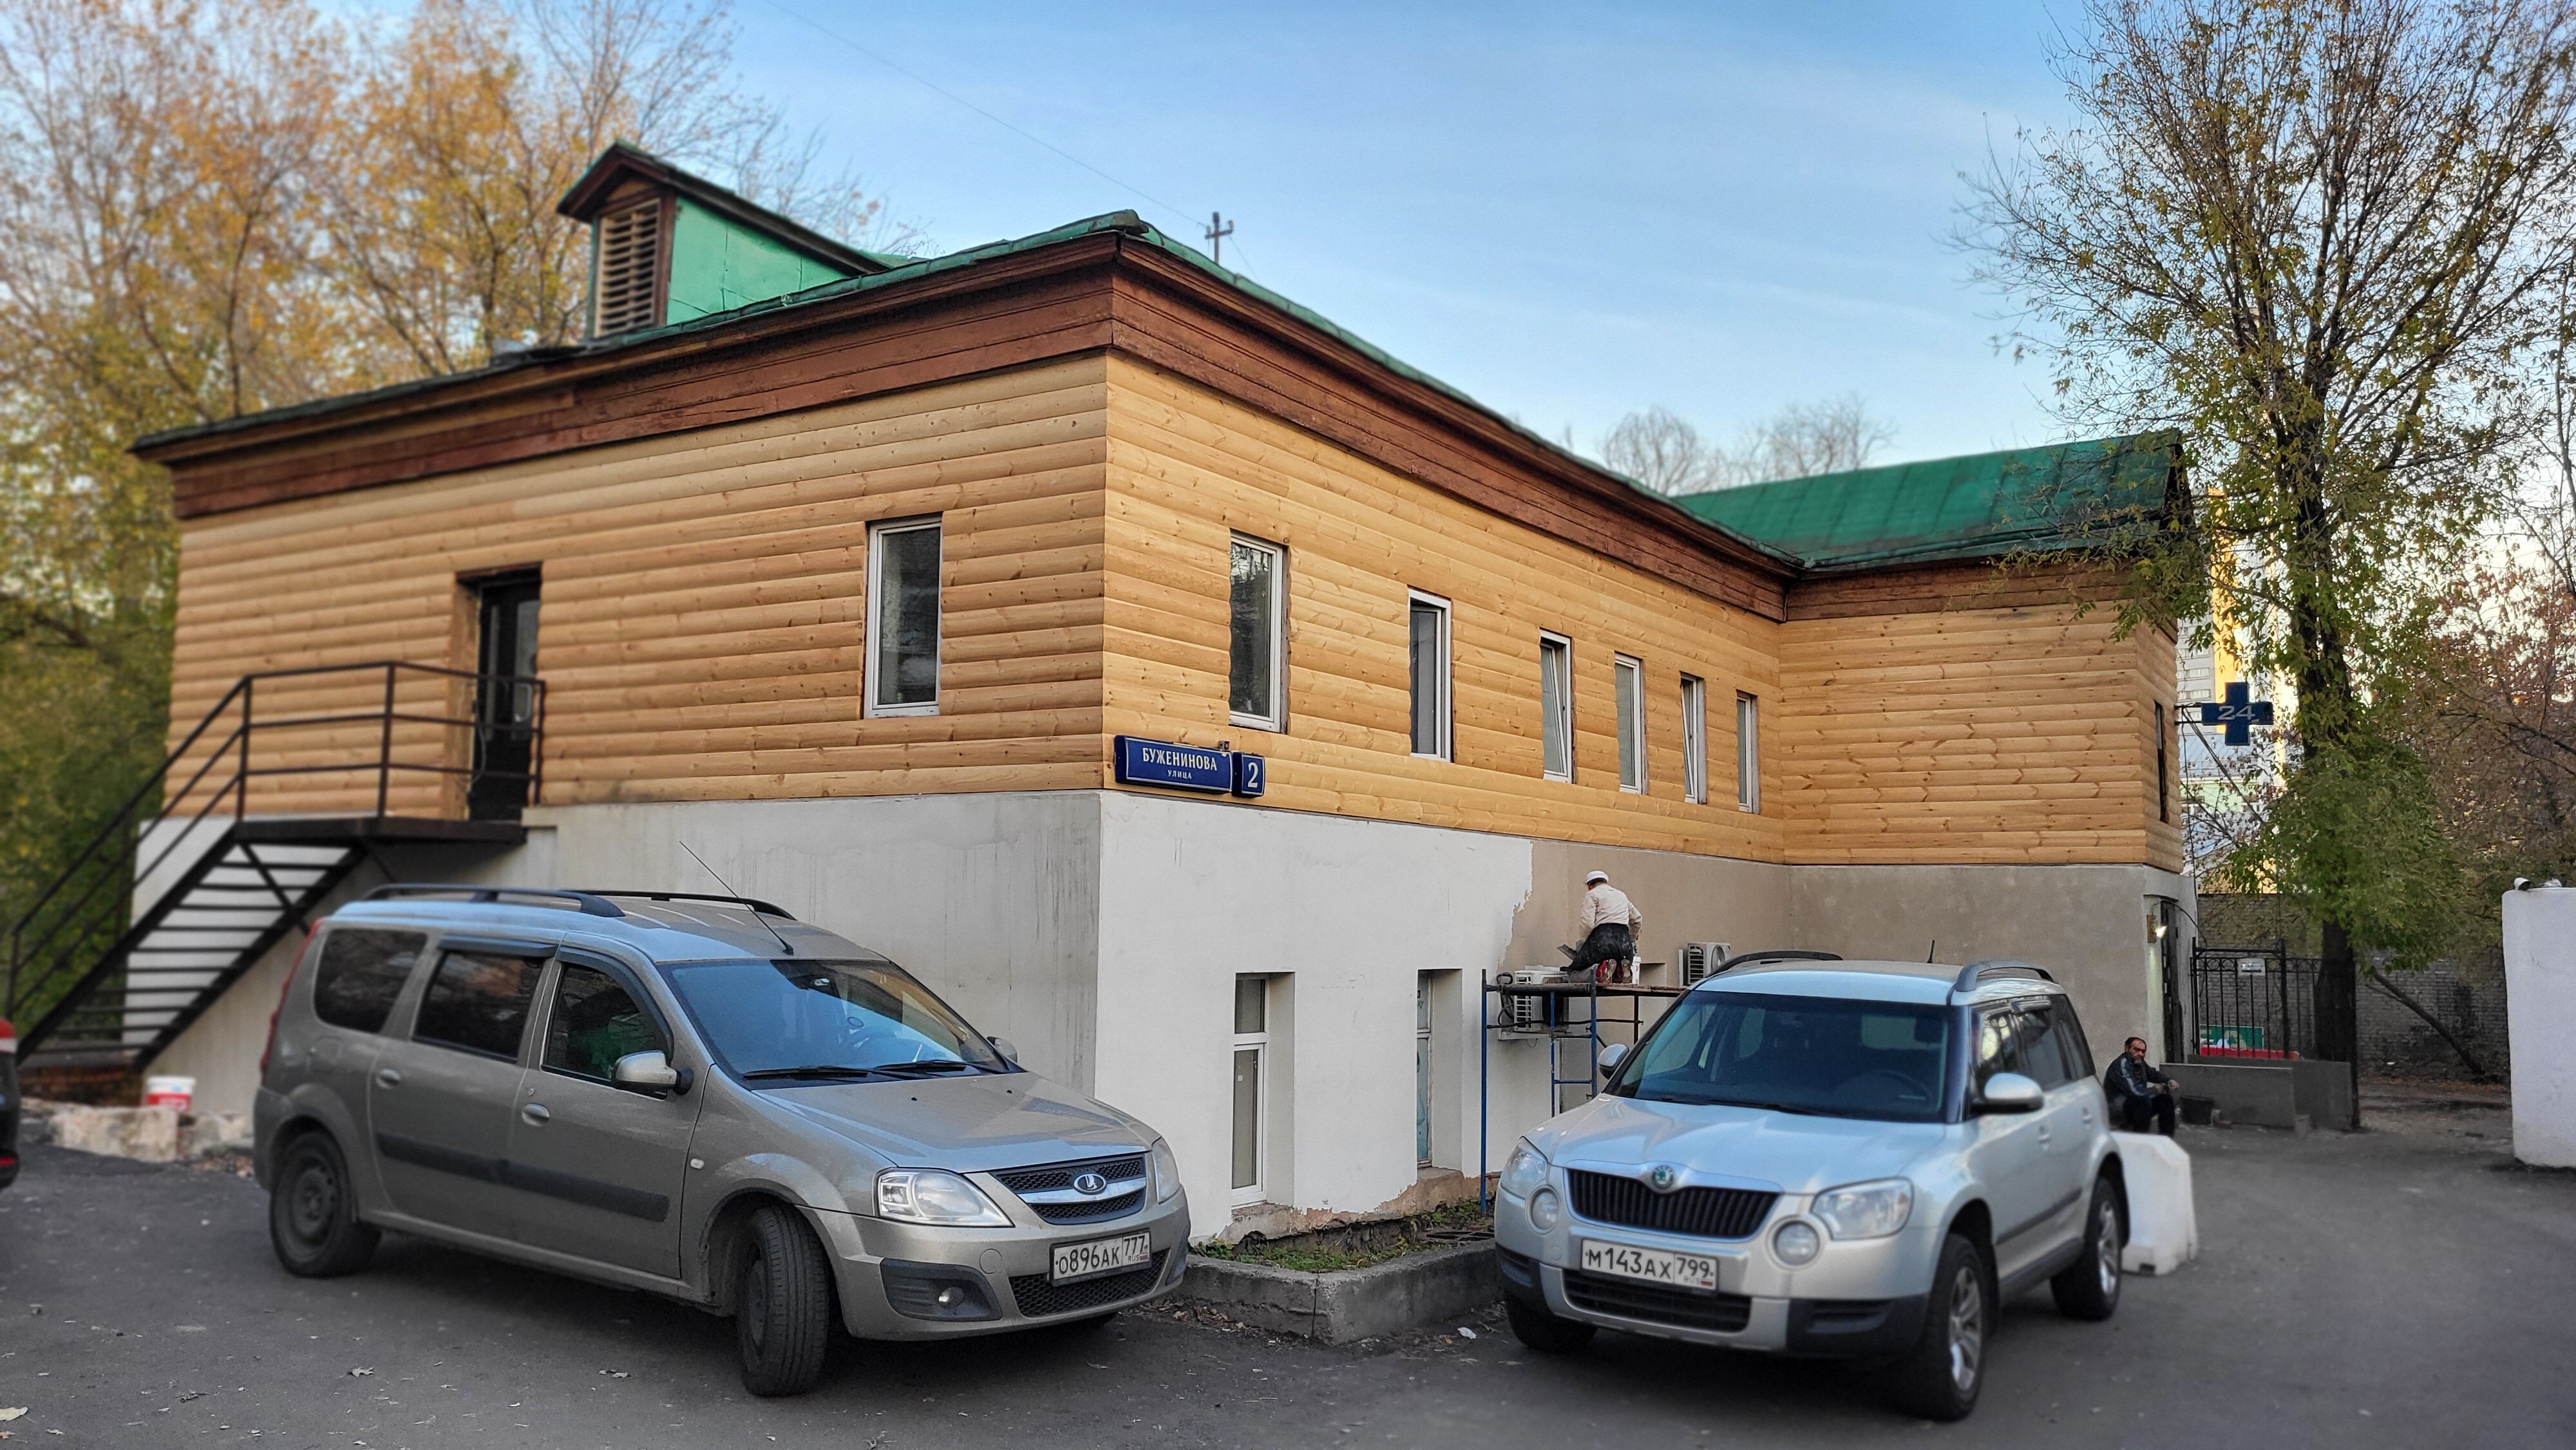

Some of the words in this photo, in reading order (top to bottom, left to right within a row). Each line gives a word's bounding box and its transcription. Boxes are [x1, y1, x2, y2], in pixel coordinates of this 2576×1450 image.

[2217, 705, 2255, 720] 24
[1142, 747, 1217, 771] БУЖЕНИНОВА
[1168, 769, 1192, 779] УЛИЦА
[1247, 762, 1258, 788] 2
[1123, 1235, 1145, 1256] 777
[1676, 1257, 1710, 1278] 799
[1683, 1276, 1701, 1285] RUS
